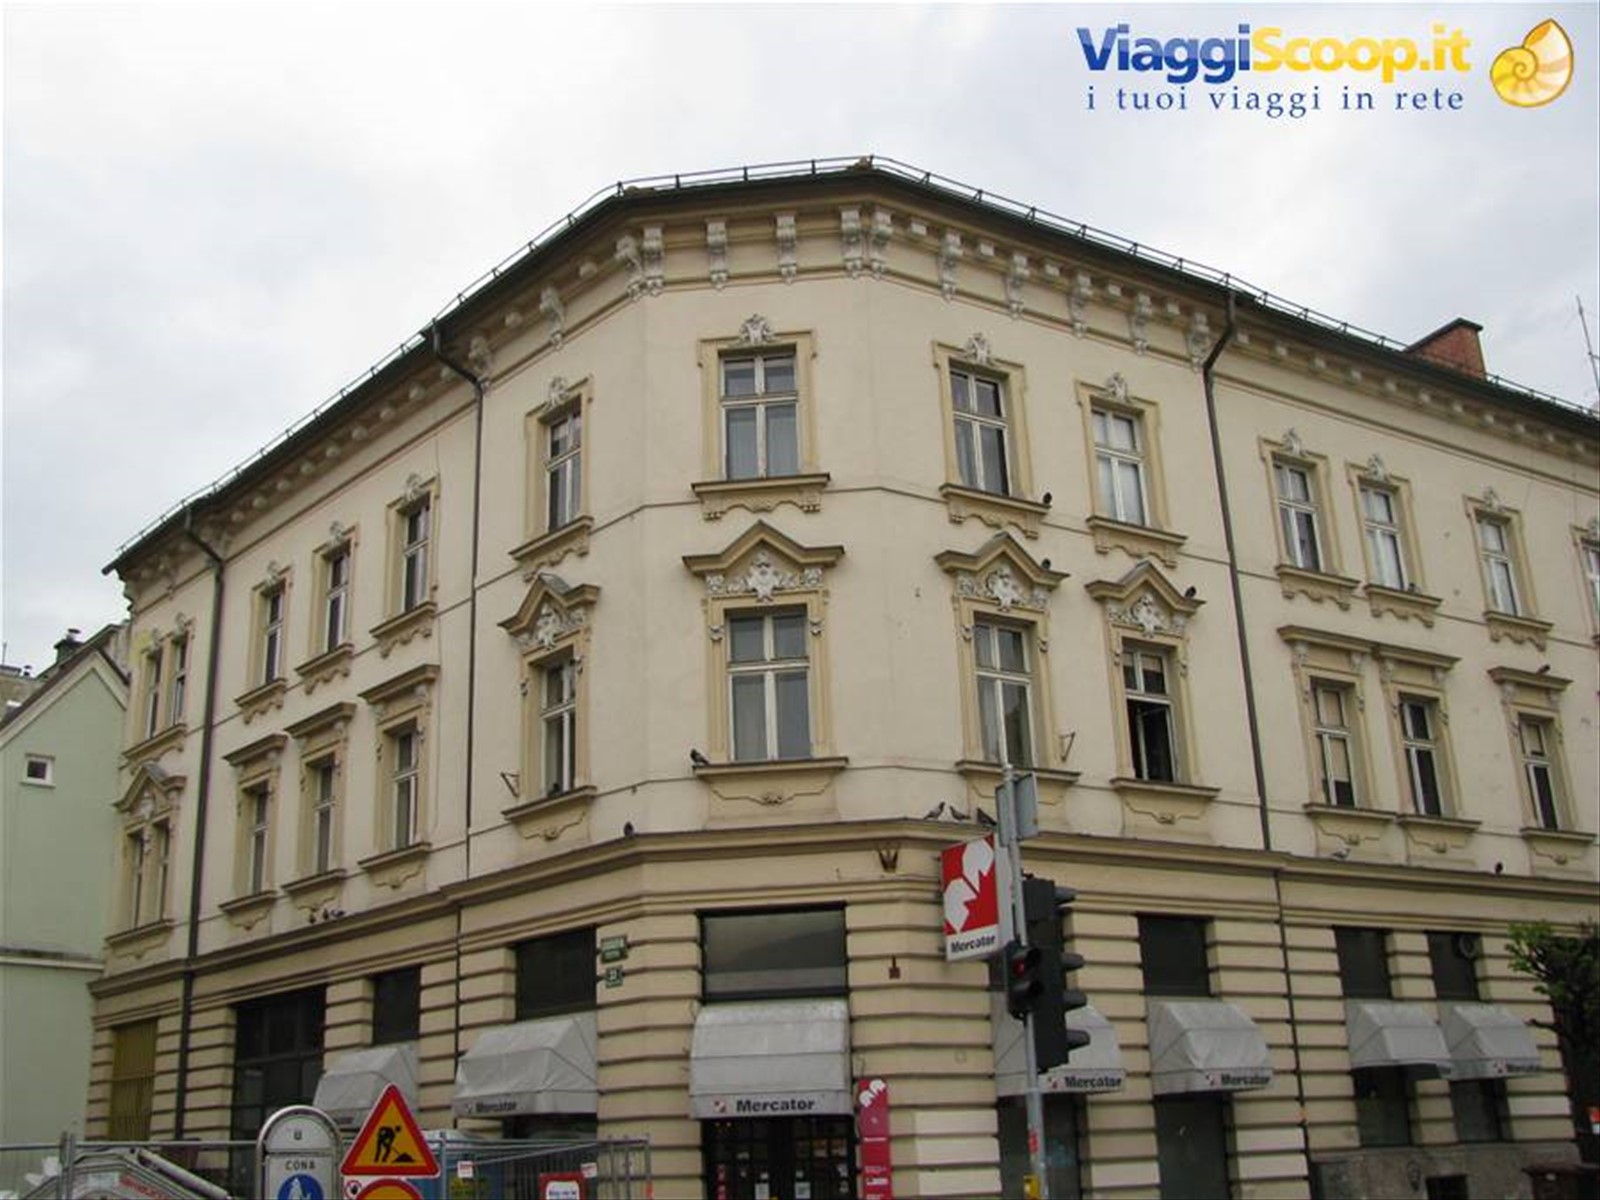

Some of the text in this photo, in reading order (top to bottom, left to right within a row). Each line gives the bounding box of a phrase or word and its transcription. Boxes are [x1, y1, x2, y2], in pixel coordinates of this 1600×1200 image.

[950, 935, 996, 953] Mercator
[1064, 1075, 1122, 1089] Mercator
[736, 1098, 816, 1113] Mercator
